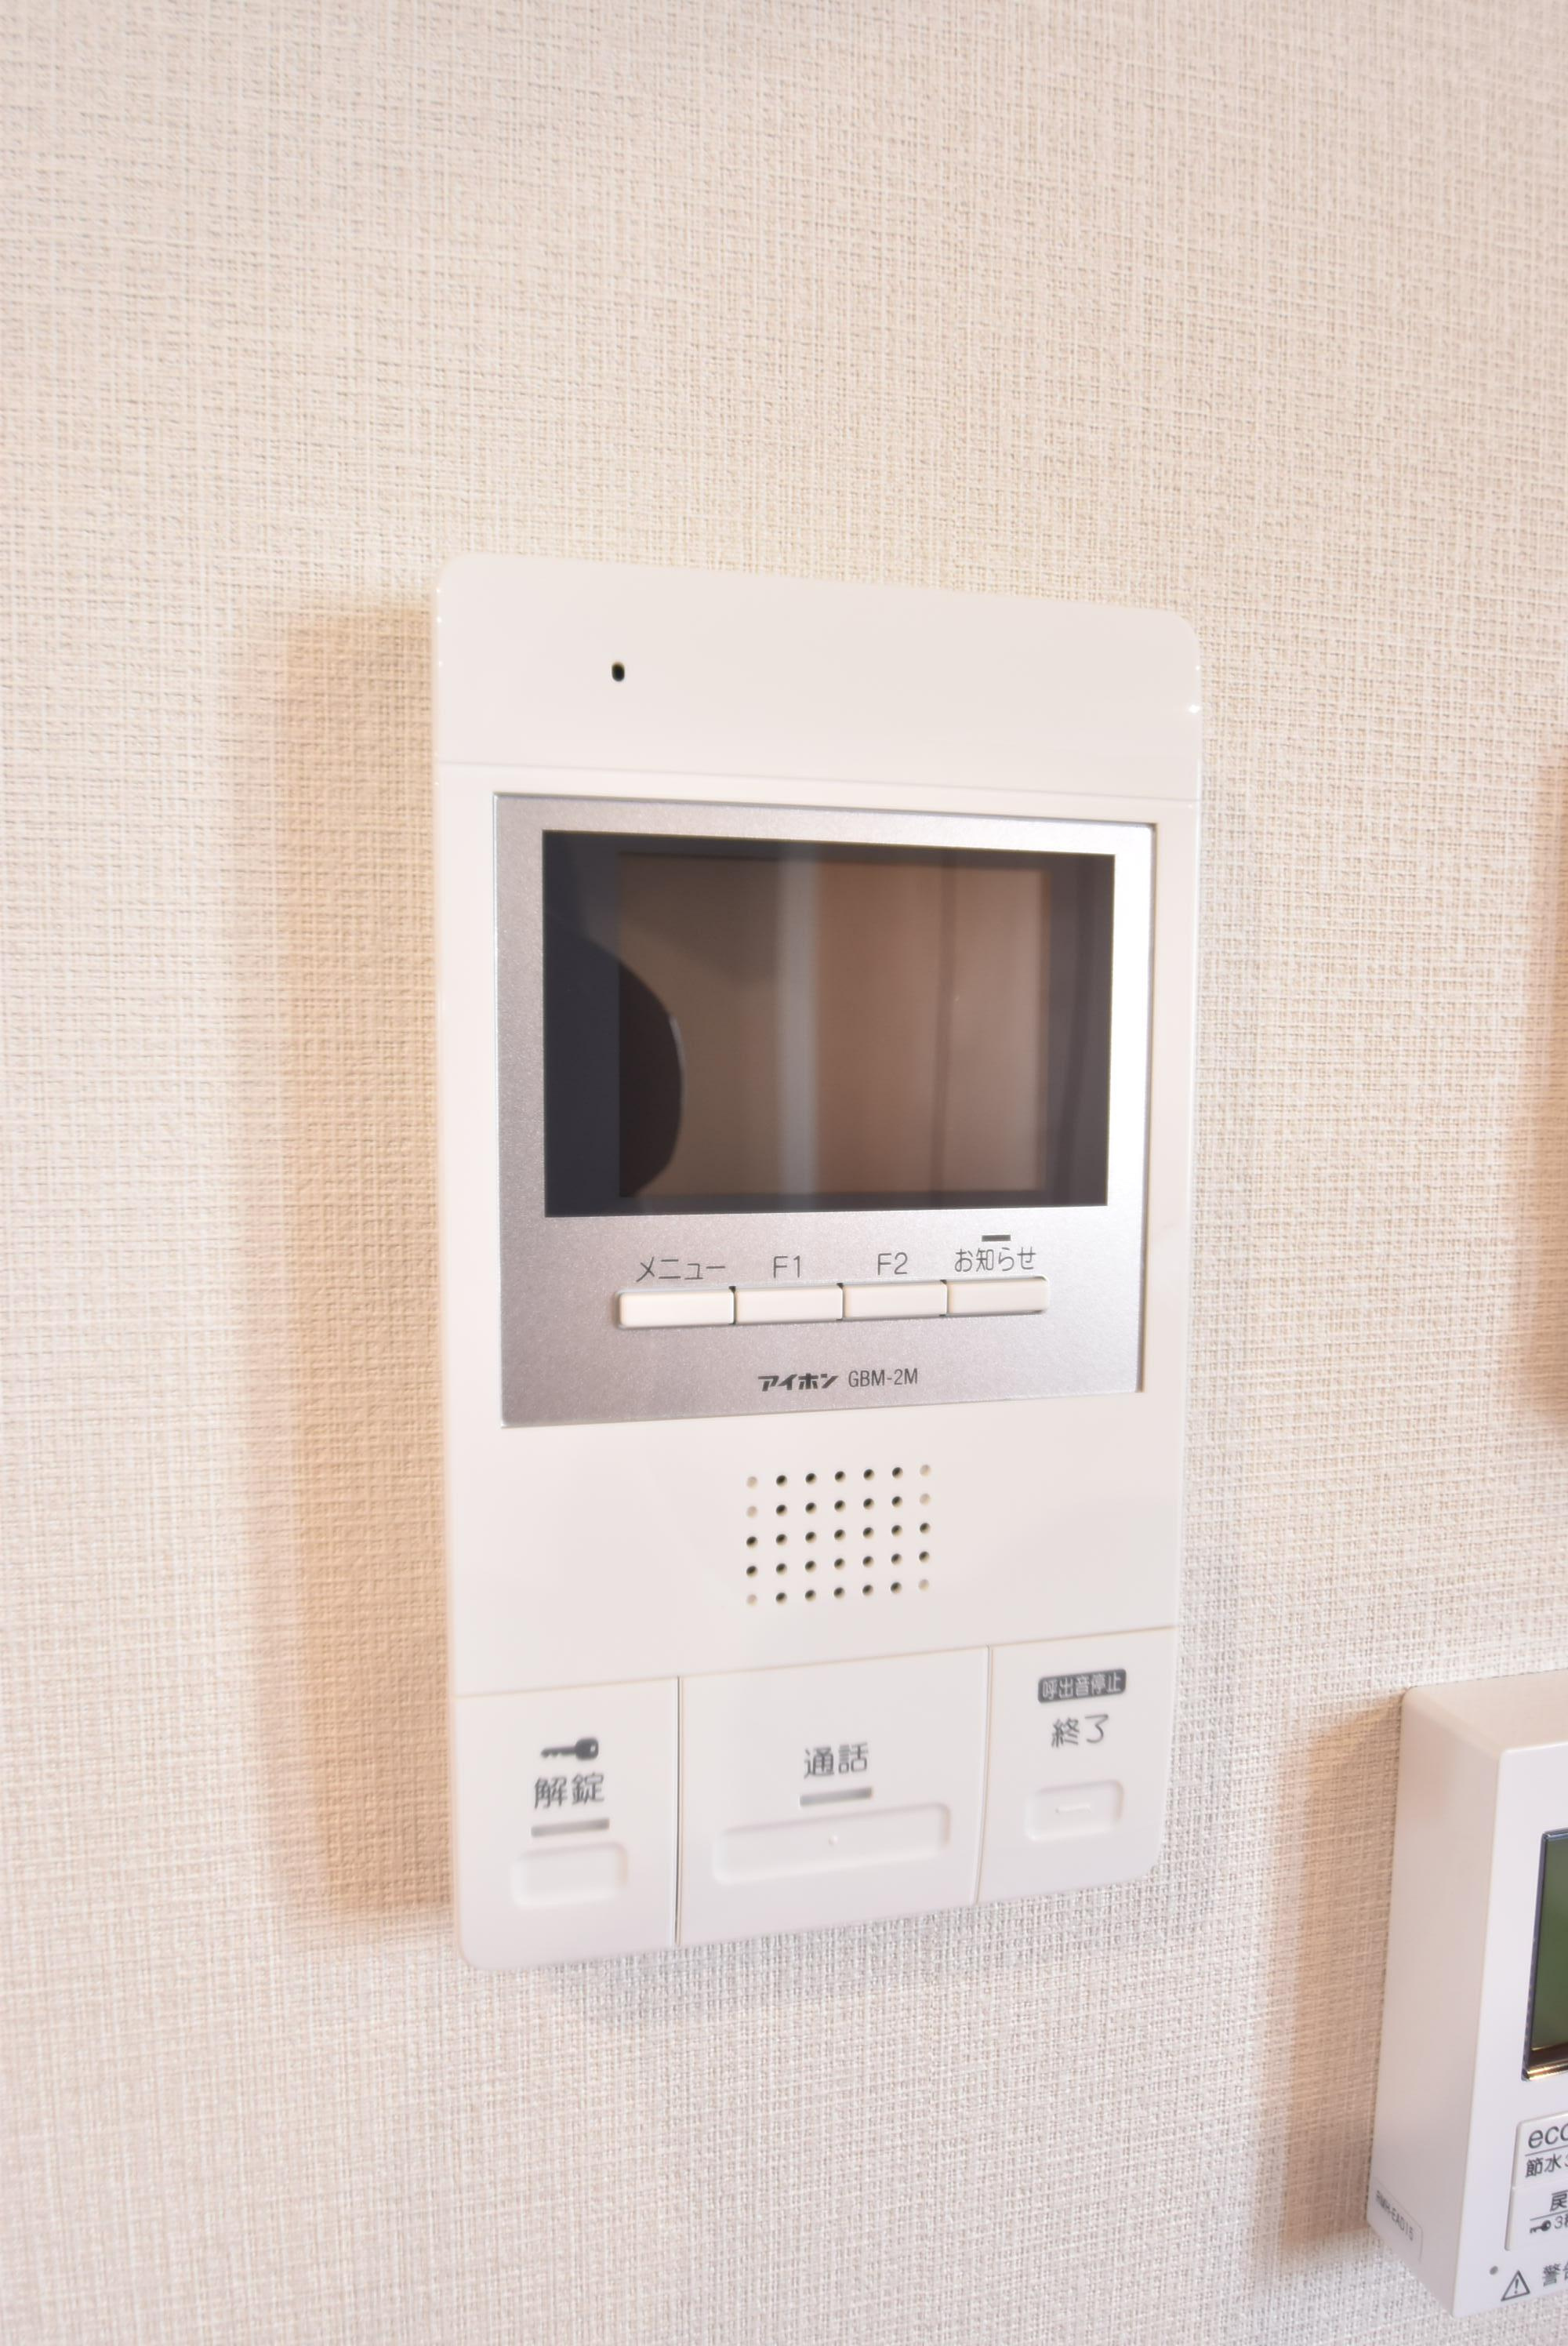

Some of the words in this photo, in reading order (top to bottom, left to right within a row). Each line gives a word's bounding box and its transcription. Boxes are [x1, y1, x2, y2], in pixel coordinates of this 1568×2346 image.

[636, 1257, 726, 1283] メニュー
[773, 1255, 800, 1279] F1
[877, 1252, 908, 1276] F2
[954, 1247, 1037, 1273] お知らせ
[757, 1373, 839, 1392] アイホン
[848, 1368, 919, 1388] GBM-2M
[1041, 1671, 1122, 1701] 呼出音停止
[1051, 1713, 1109, 1748] 終了
[804, 1741, 869, 1780] 通話
[534, 1772, 605, 1810] 解錠
